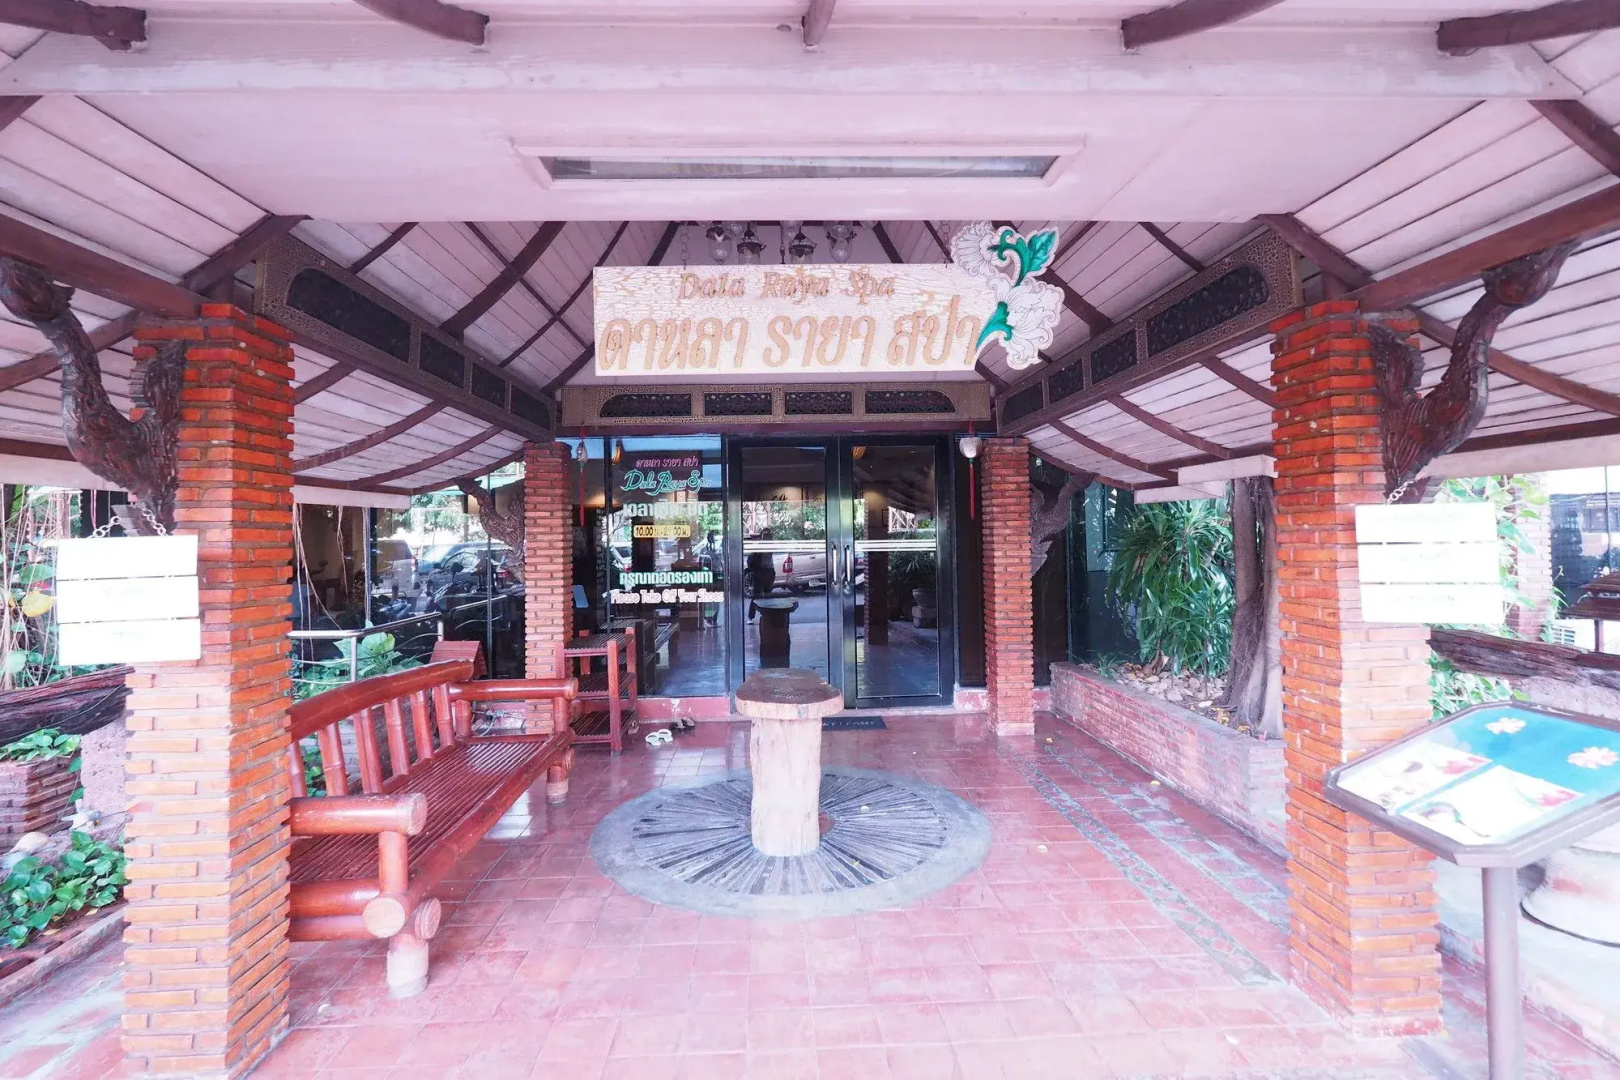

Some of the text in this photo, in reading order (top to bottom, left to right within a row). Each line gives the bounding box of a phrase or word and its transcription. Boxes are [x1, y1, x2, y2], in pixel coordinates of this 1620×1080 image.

[678, 272, 746, 300] Dala
[844, 270, 895, 305] Spa
[599, 294, 981, 370] ดาหลา รายา สปา
[620, 469, 657, 491] Dala
[687, 470, 713, 494] Spa
[609, 588, 724, 604] Please Take Off Your Shoes
